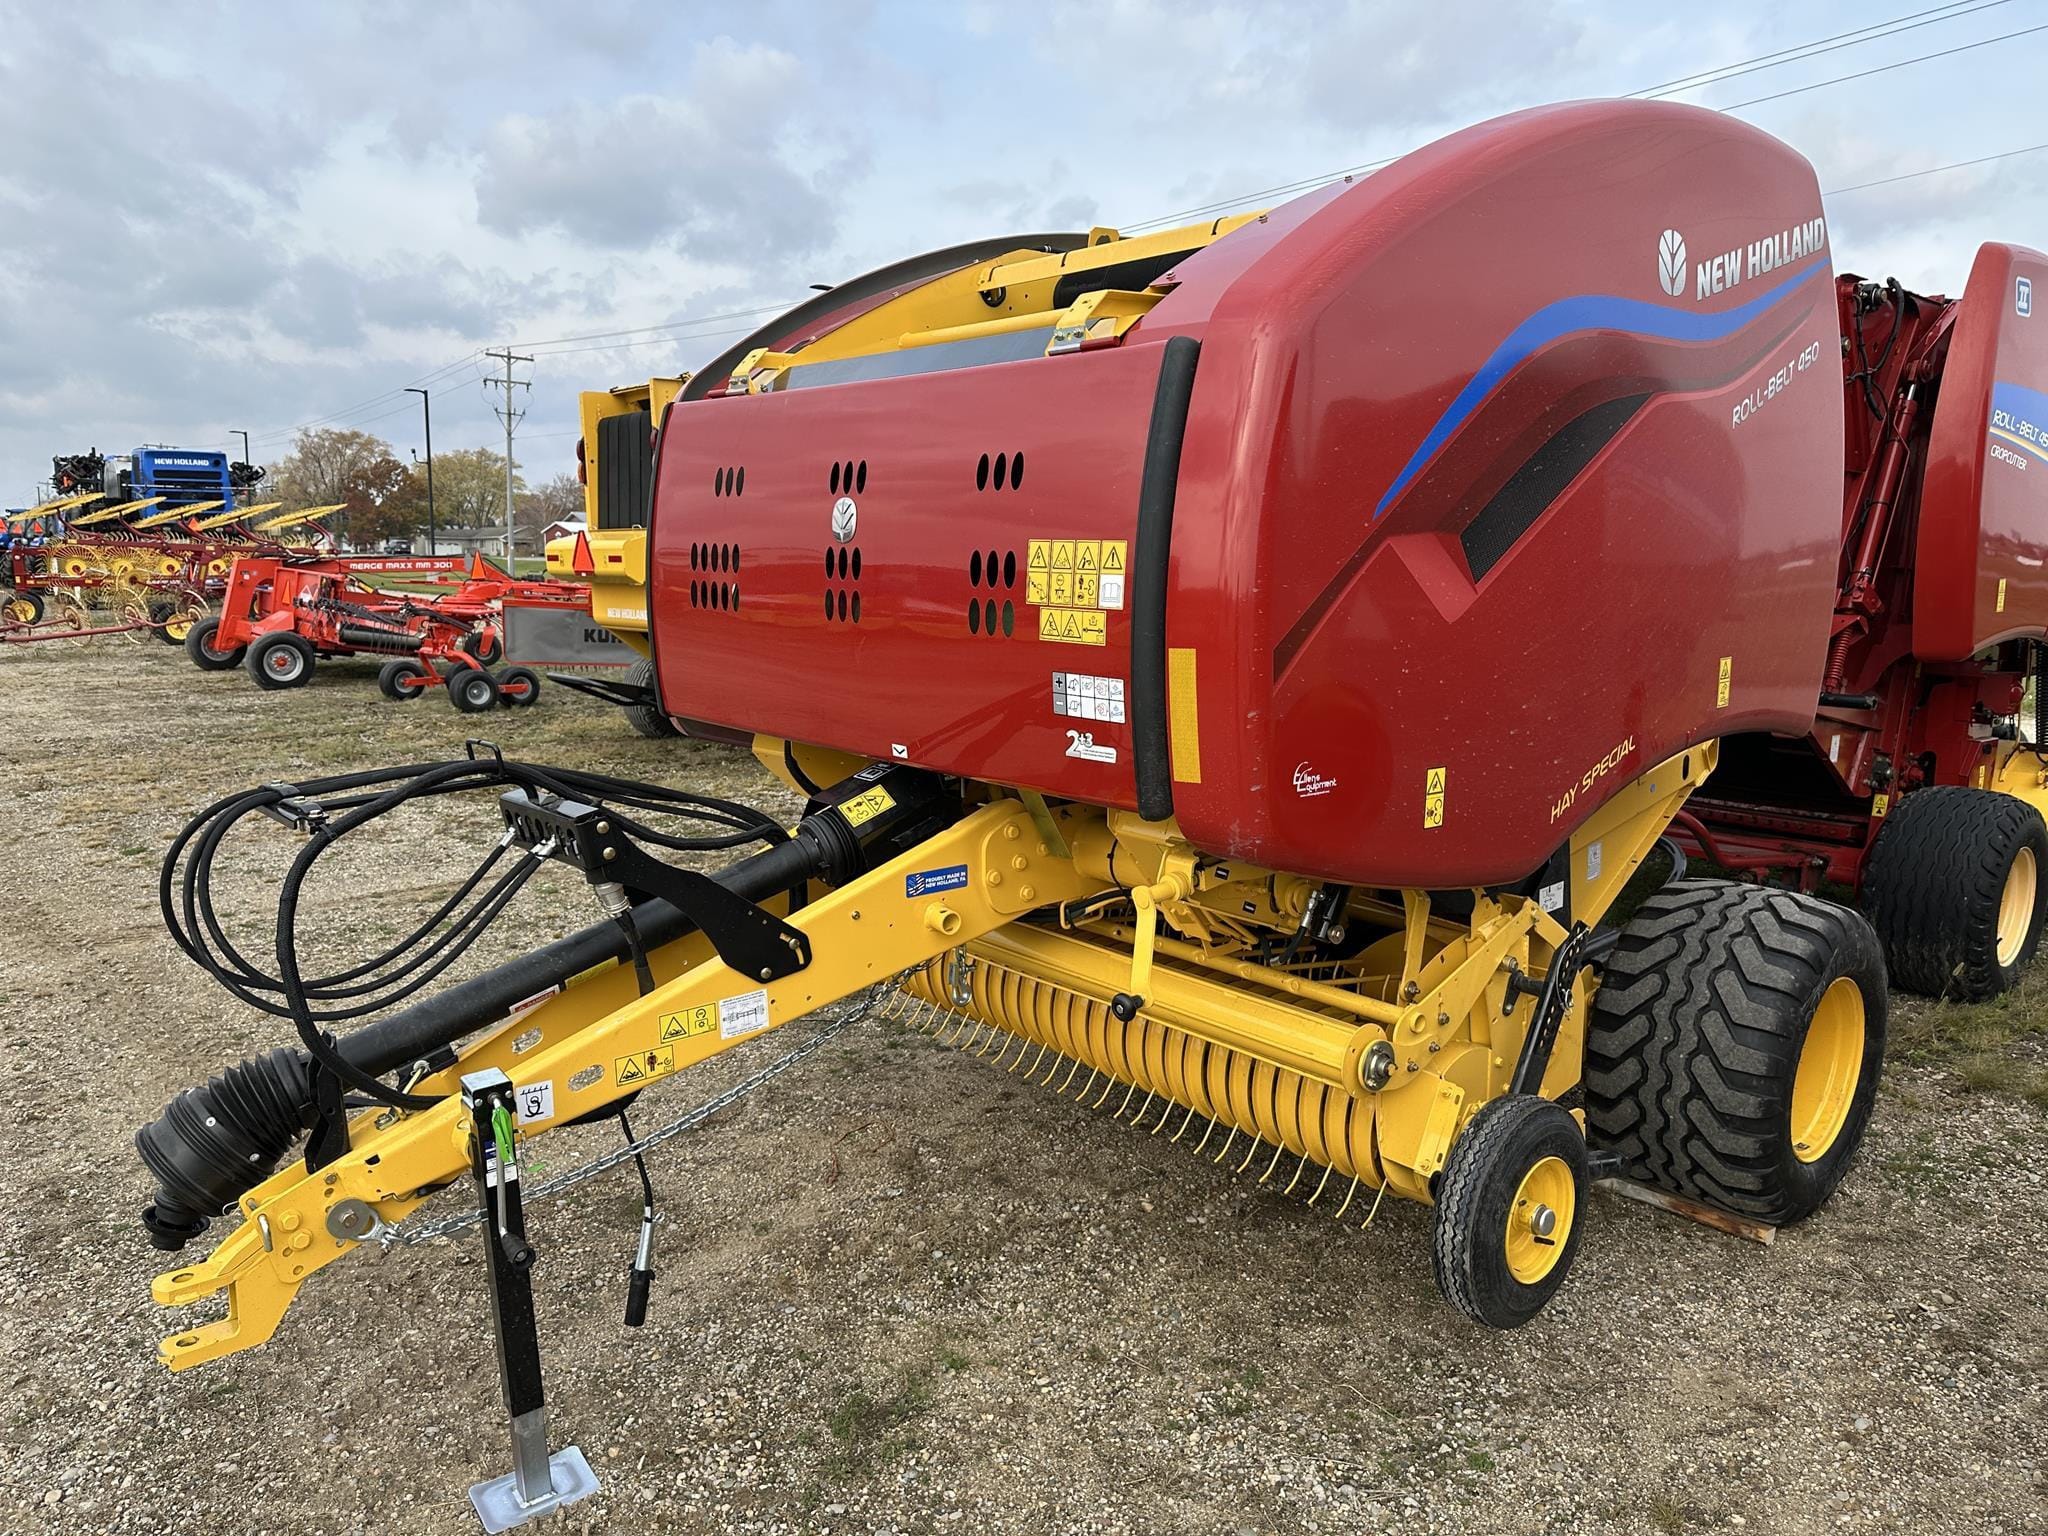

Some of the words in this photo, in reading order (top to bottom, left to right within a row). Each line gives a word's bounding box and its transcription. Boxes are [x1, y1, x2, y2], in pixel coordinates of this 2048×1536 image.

[1697, 248, 1742, 301] NEW
[1747, 217, 1825, 280] HOLLAND
[1732, 360, 1795, 430] ROLL-BELT
[1798, 341, 1819, 372] 450
[1992, 409, 2040, 442] ROLL-BELT
[2039, 431, 2048, 448] 45
[174, 458, 209, 466] HOLLAND
[1991, 444, 2028, 471] CROPCUTTER
[607, 607, 622, 617] NEW
[622, 608, 648, 619] HOLLAN
[1550, 782, 1579, 825] HAY
[1581, 735, 1636, 794] SPECIAL
[925, 874, 946, 883] PROUDLY
